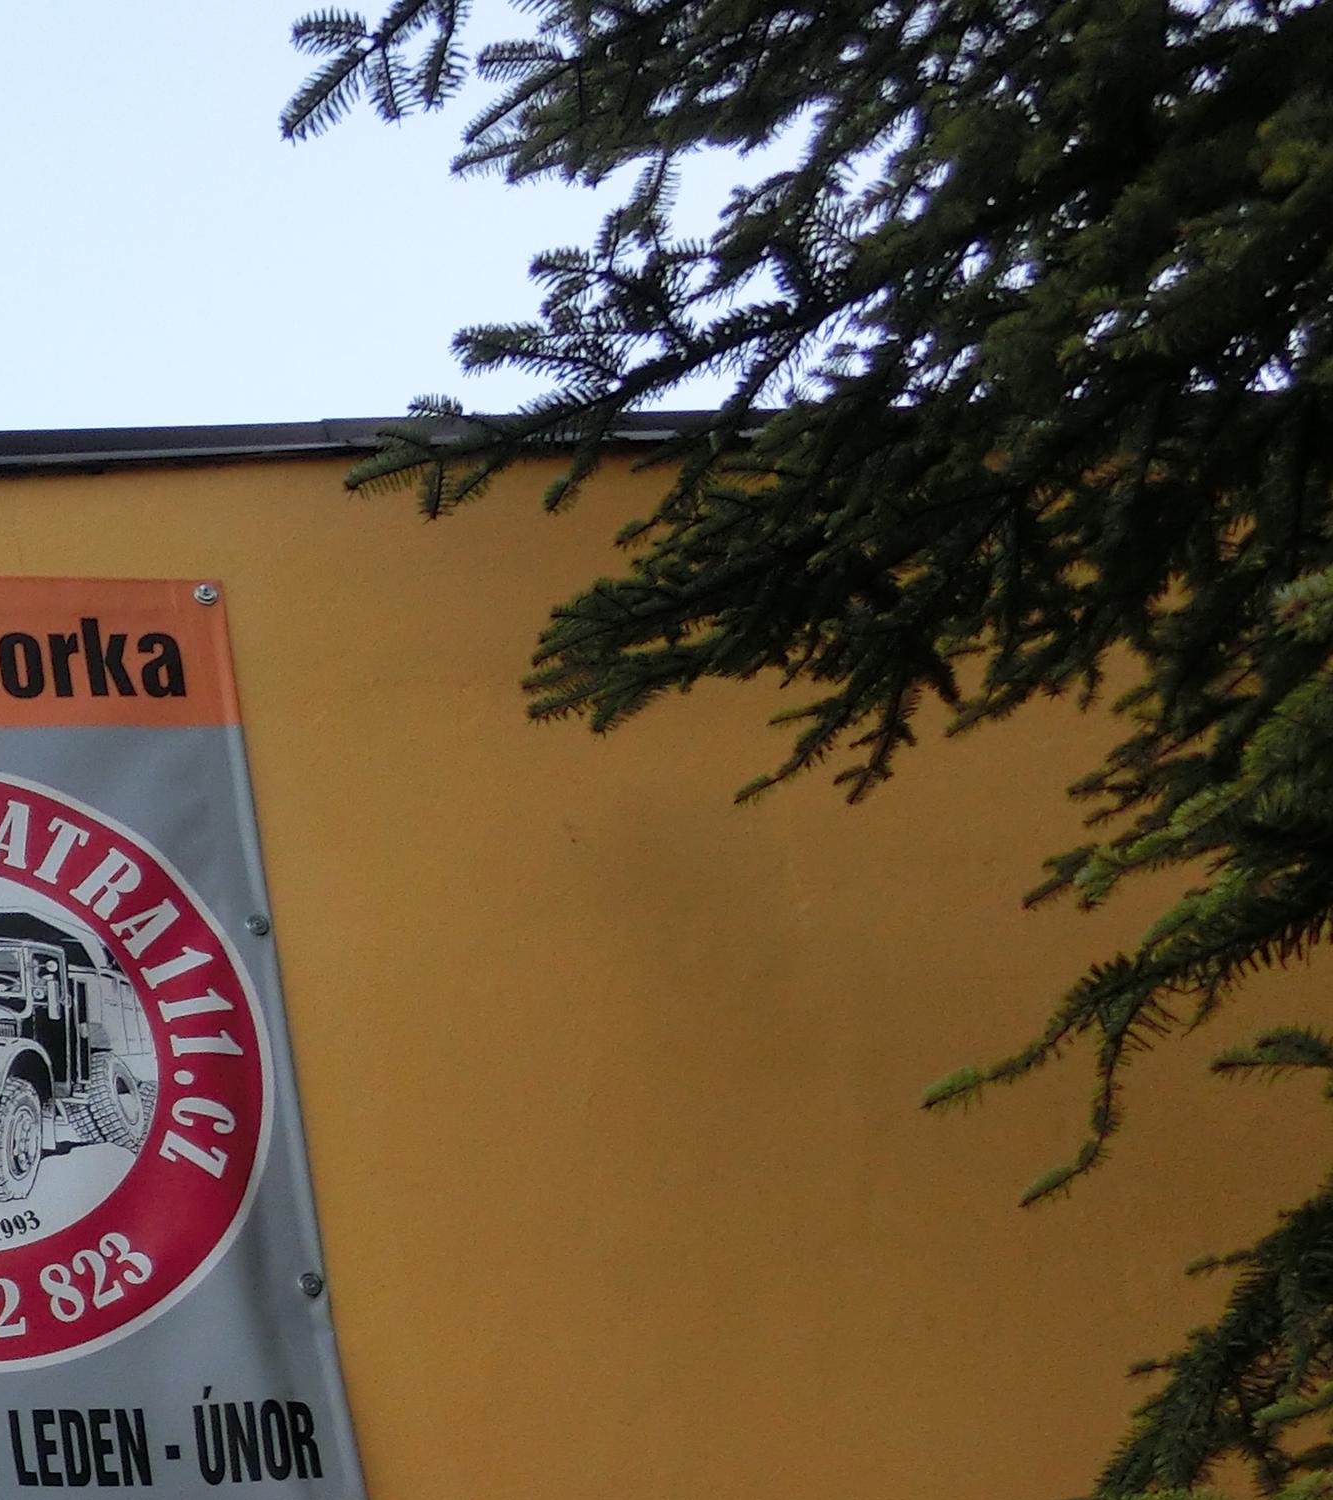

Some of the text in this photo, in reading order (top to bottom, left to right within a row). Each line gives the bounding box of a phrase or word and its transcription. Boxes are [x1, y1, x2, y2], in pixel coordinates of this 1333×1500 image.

[39, 1231, 152, 1323] 823
[10, 1407, 153, 1487] LEDEN
[192, 1386, 323, 1486] ÚNOR
